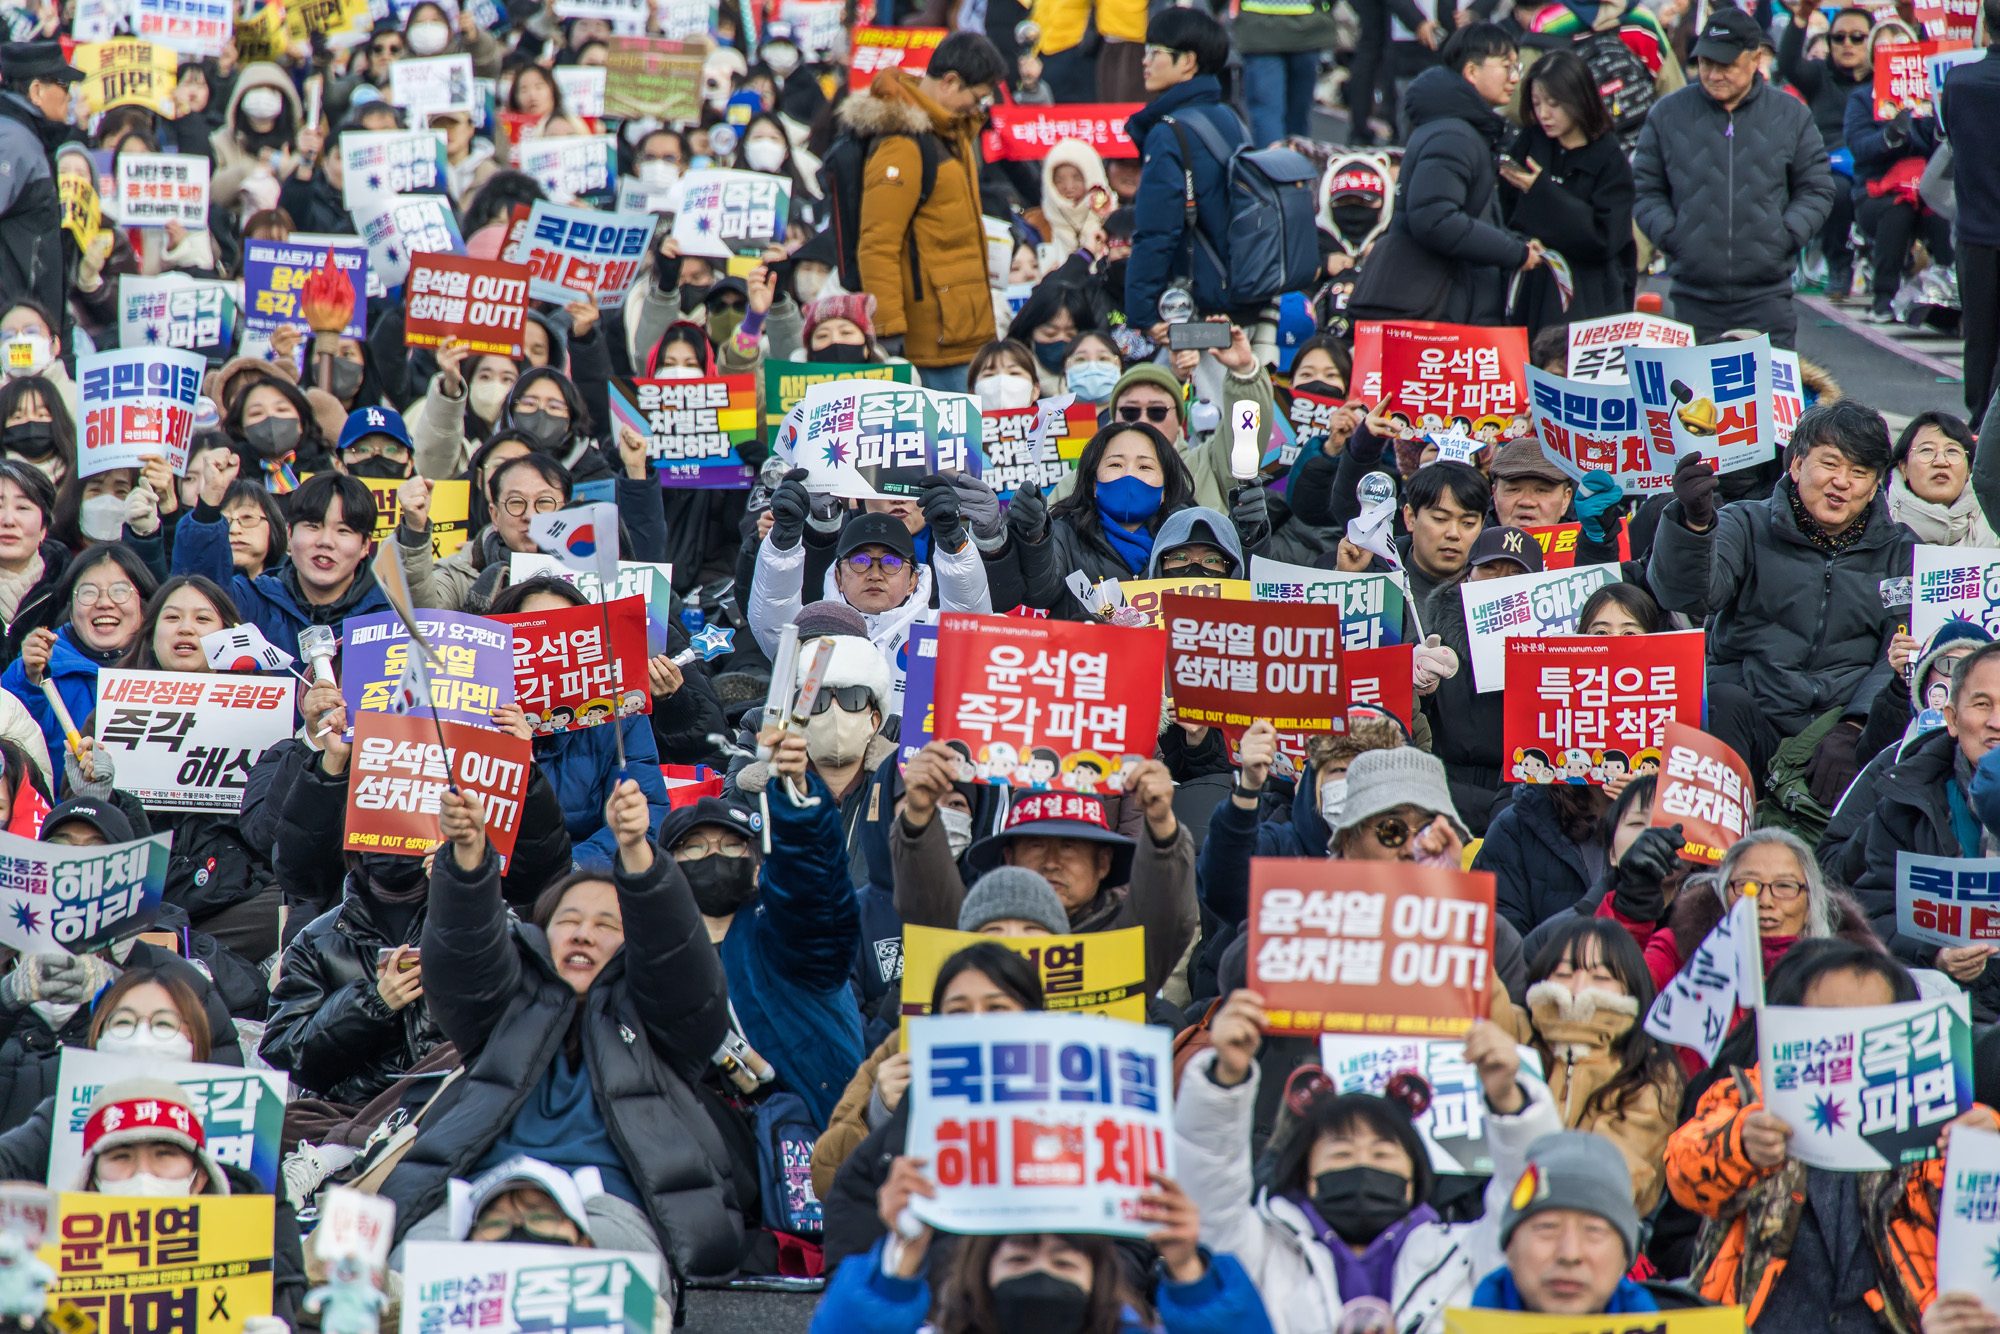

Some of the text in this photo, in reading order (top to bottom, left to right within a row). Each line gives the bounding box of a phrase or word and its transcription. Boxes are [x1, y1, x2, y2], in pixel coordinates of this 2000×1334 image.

[102, 71, 152, 105] 파면
[1011, 114, 1108, 146] 대한민국은
[1185, 169, 1195, 200] SONY
[534, 215, 649, 255] 국민의힘
[721, 211, 776, 239] 파면
[412, 267, 526, 304] 윤석열 OUT!
[528, 248, 639, 291] 해 체!
[170, 286, 222, 318] 즉각
[256, 289, 296, 318] 즉각
[410, 293, 524, 330] 성차별 OUT!
[169, 318, 222, 349] 파면
[1573, 321, 1690, 347] 내란정범 국힘당
[1418, 347, 1500, 380] 윤석열
[1635, 351, 1757, 406] 내 란
[84, 363, 200, 406] 국민의힘
[637, 383, 730, 410] 윤석열도
[1399, 380, 1516, 414] 즉각 파면
[366, 407, 385, 427] LA
[648, 408, 719, 434] 차별도
[807, 411, 854, 441] 윤석열
[809, 396, 856, 421] 내란수괴
[860, 392, 926, 430] 즉각
[86, 407, 115, 450] 해
[165, 406, 193, 451] 체!
[1440, 437, 1470, 450] 윤석열
[1540, 417, 1572, 463] 해
[1645, 400, 1758, 455] 종 식
[857, 431, 926, 469] 파면
[1444, 448, 1465, 459] 파면
[1502, 531, 1523, 553] NY
[1257, 582, 1304, 598] 내란동조
[1920, 566, 1980, 587] 내란동조
[1920, 582, 1980, 603] 국민의힘
[1472, 591, 1530, 622] 내란동조
[1474, 607, 1531, 635] 국민의힘
[448, 623, 506, 650] 요구한다
[514, 626, 604, 669] 윤석열
[981, 623, 1048, 638] www.nanum.com
[1171, 617, 1335, 659] 윤석열 OUT!
[1548, 644, 1608, 654] www.nanum.com
[559, 659, 624, 700] 파면
[985, 645, 1108, 701] 윤석열
[1174, 654, 1337, 695] 성차별 OUT!
[1537, 666, 1678, 708] 특검으로
[101, 679, 286, 710] 내란정범 국힘당
[428, 679, 499, 716] 파면!
[101, 709, 197, 752] 즉각
[956, 692, 1127, 752] 즉각 파면
[1206, 710, 1224, 722] OUT
[1538, 706, 1677, 750] 내란 척결
[358, 737, 524, 795] 윤석열 OUT!
[1667, 745, 1741, 803] 윤석열
[70, 806, 97, 816] Jeep
[354, 775, 451, 815] 성차별
[1662, 781, 1742, 836] 성차별
[348, 832, 380, 845] 윤석열
[381, 835, 404, 847] OUT
[1684, 841, 1706, 856] OUT
[53, 839, 152, 902] 해체
[53, 882, 145, 943] 하라
[1259, 888, 1488, 946] 윤석열 OUT!
[1913, 898, 1962, 937] 해
[1256, 936, 1489, 991] 성차별 OUT!
[1773, 1033, 1854, 1060] 내란수괴
[1862, 1003, 1955, 1077] 즉각
[1339, 1043, 1418, 1075] 내란수괴
[1773, 1057, 1854, 1090] 윤석열
[929, 1042, 1159, 1113] 국민의힘
[1861, 1062, 1957, 1136] 파면
[935, 1116, 1165, 1188] 해 체!
[61, 1204, 201, 1272] 윤석열
[215, 1265, 226, 1278] 수
[228, 1262, 250, 1275] 없다
[419, 1271, 507, 1303] 내란수괴
[513, 1258, 632, 1330] 즉각
